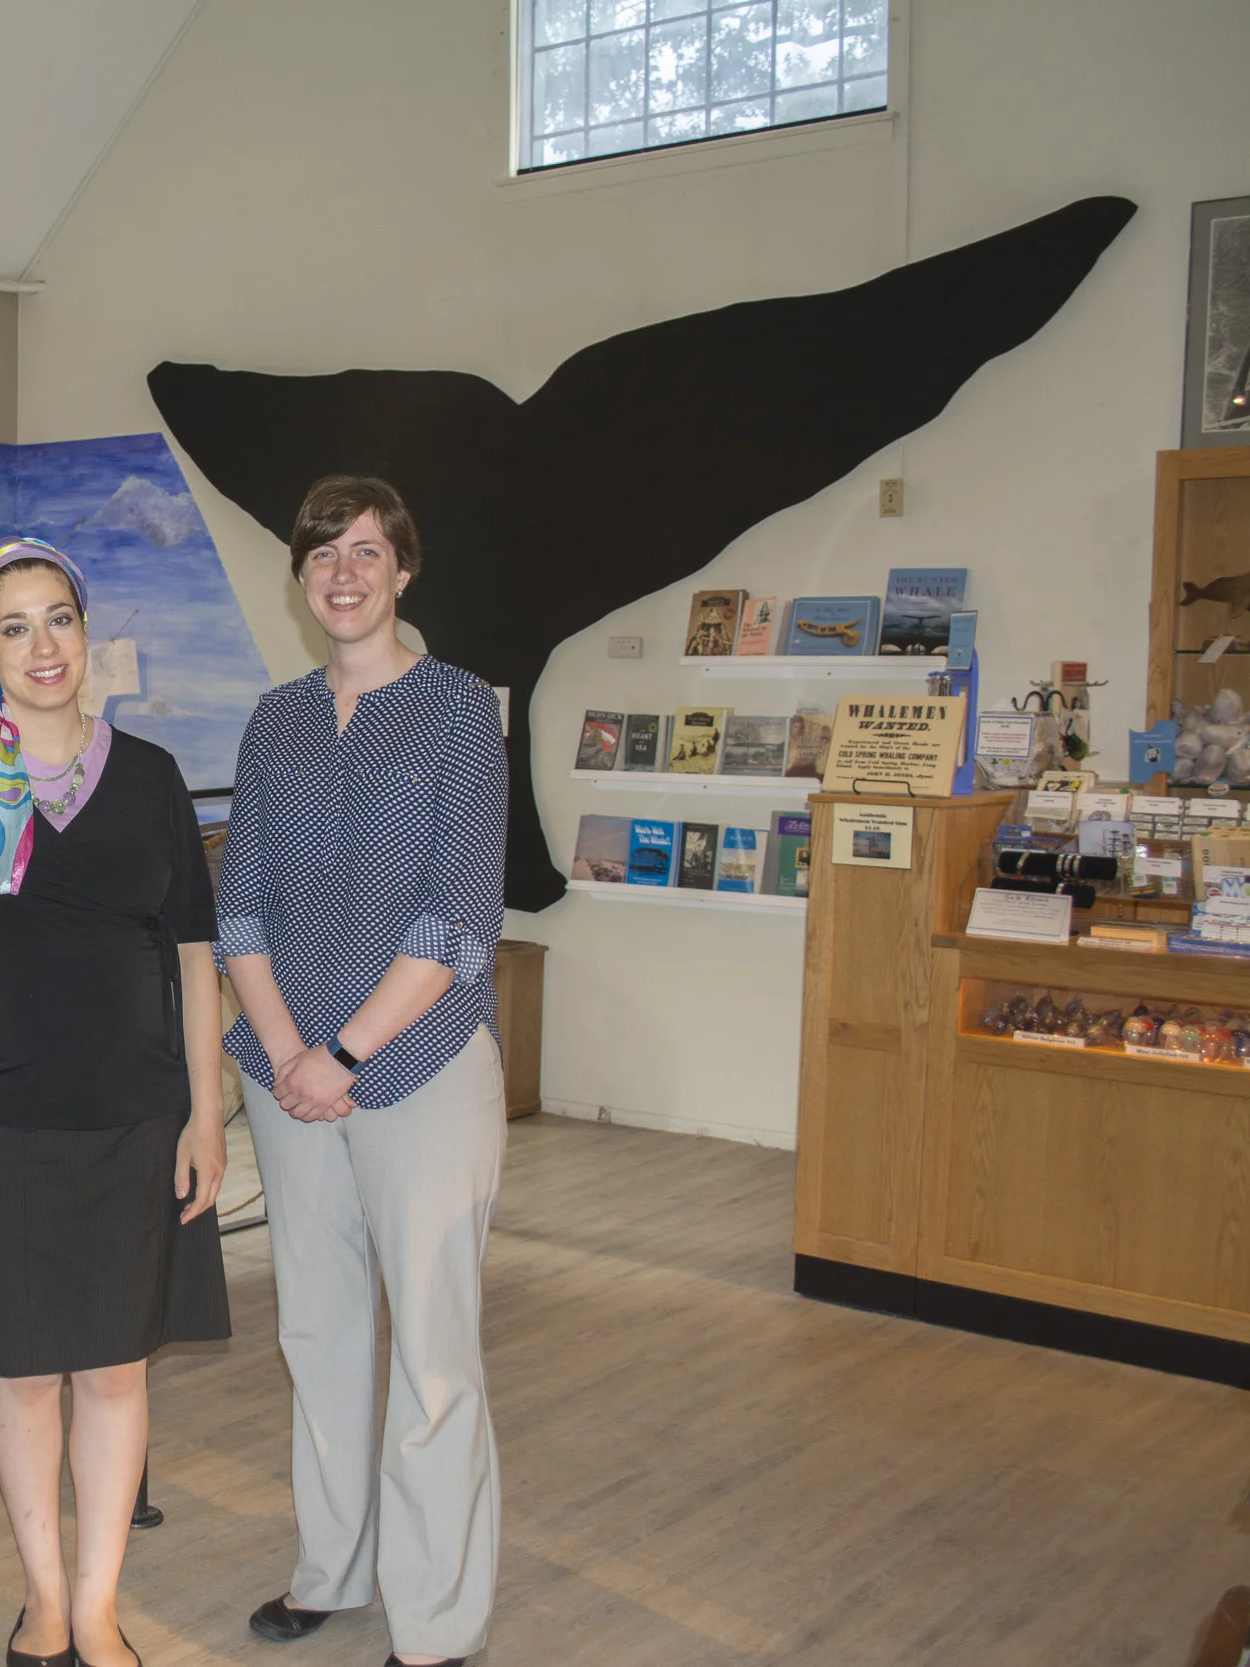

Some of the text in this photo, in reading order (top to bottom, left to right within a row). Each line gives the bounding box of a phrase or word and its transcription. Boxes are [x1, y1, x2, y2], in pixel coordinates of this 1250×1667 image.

[895, 586, 957, 597] WHALE
[848, 704, 947, 720] WHALEMEN
[858, 721, 931, 731] WANTED.
